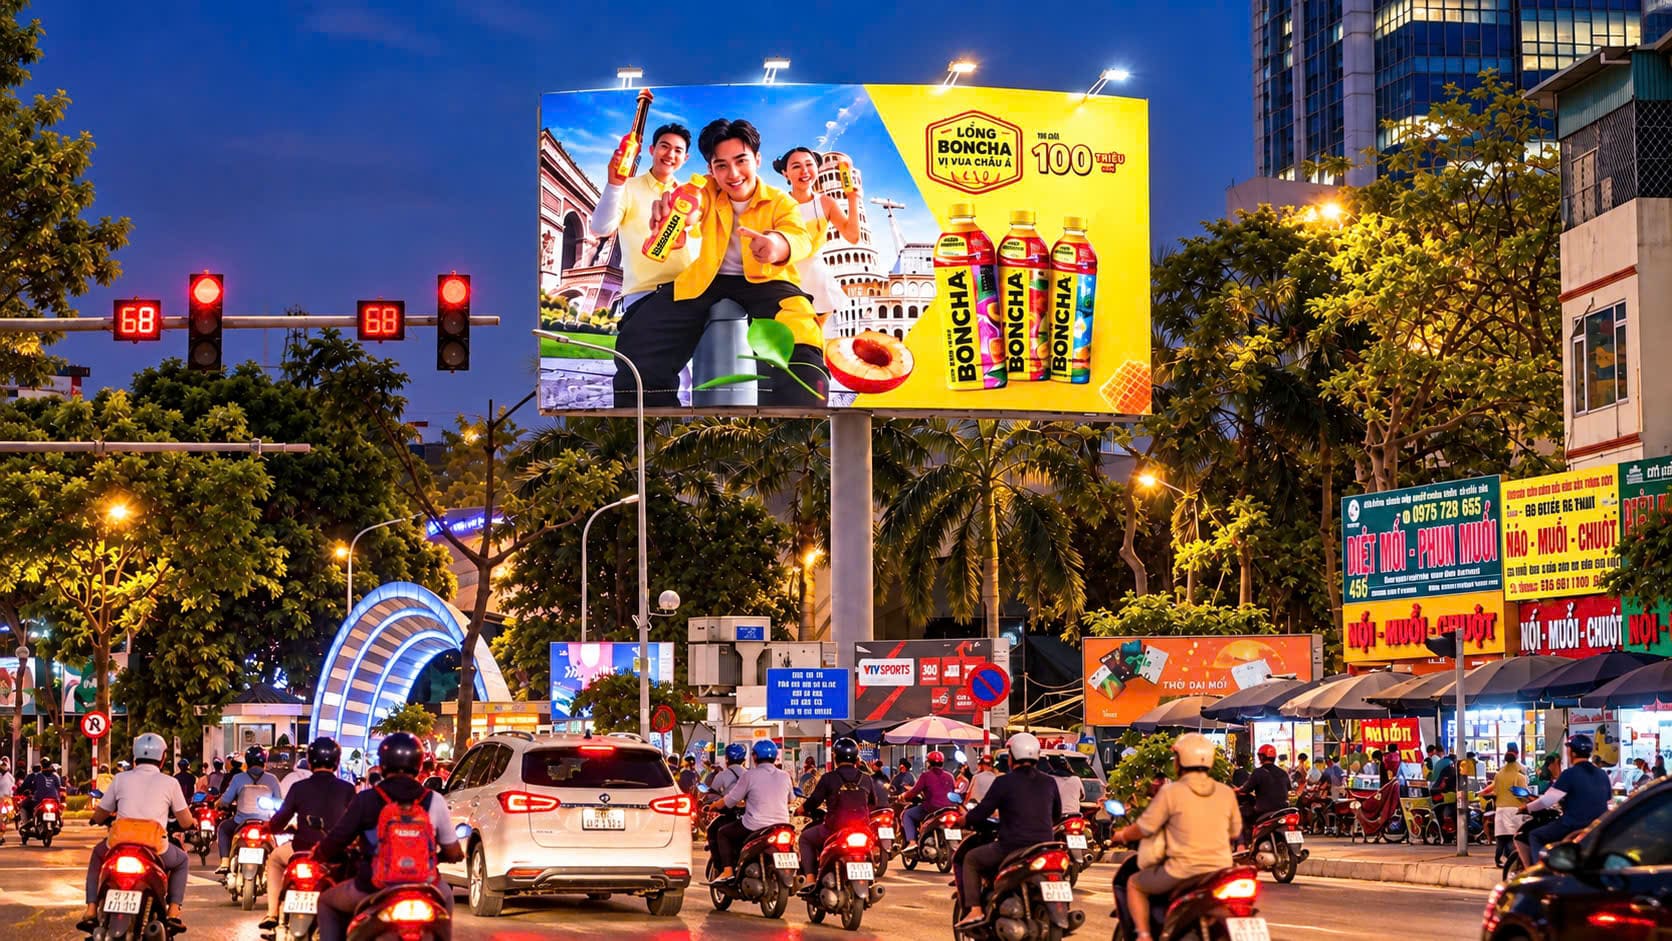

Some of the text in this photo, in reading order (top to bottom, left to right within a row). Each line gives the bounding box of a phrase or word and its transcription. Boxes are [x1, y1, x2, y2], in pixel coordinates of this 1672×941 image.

[938, 139, 1012, 156] BONCHA
[1031, 142, 1093, 176] 100
[951, 157, 972, 166] VUA
[121, 306, 155, 333] 68
[365, 307, 398, 333] 68
[947, 270, 977, 383] BONCHA
[1007, 271, 1025, 373] BONCHA
[1051, 275, 1072, 373] BONCHA
[1412, 504, 1438, 523] 0975
[1440, 501, 1459, 519] 728
[1461, 497, 1482, 516] 655
[1417, 524, 1455, 569] PHUN
[1348, 578, 1368, 599] 456
[922, 664, 937, 675] 300
